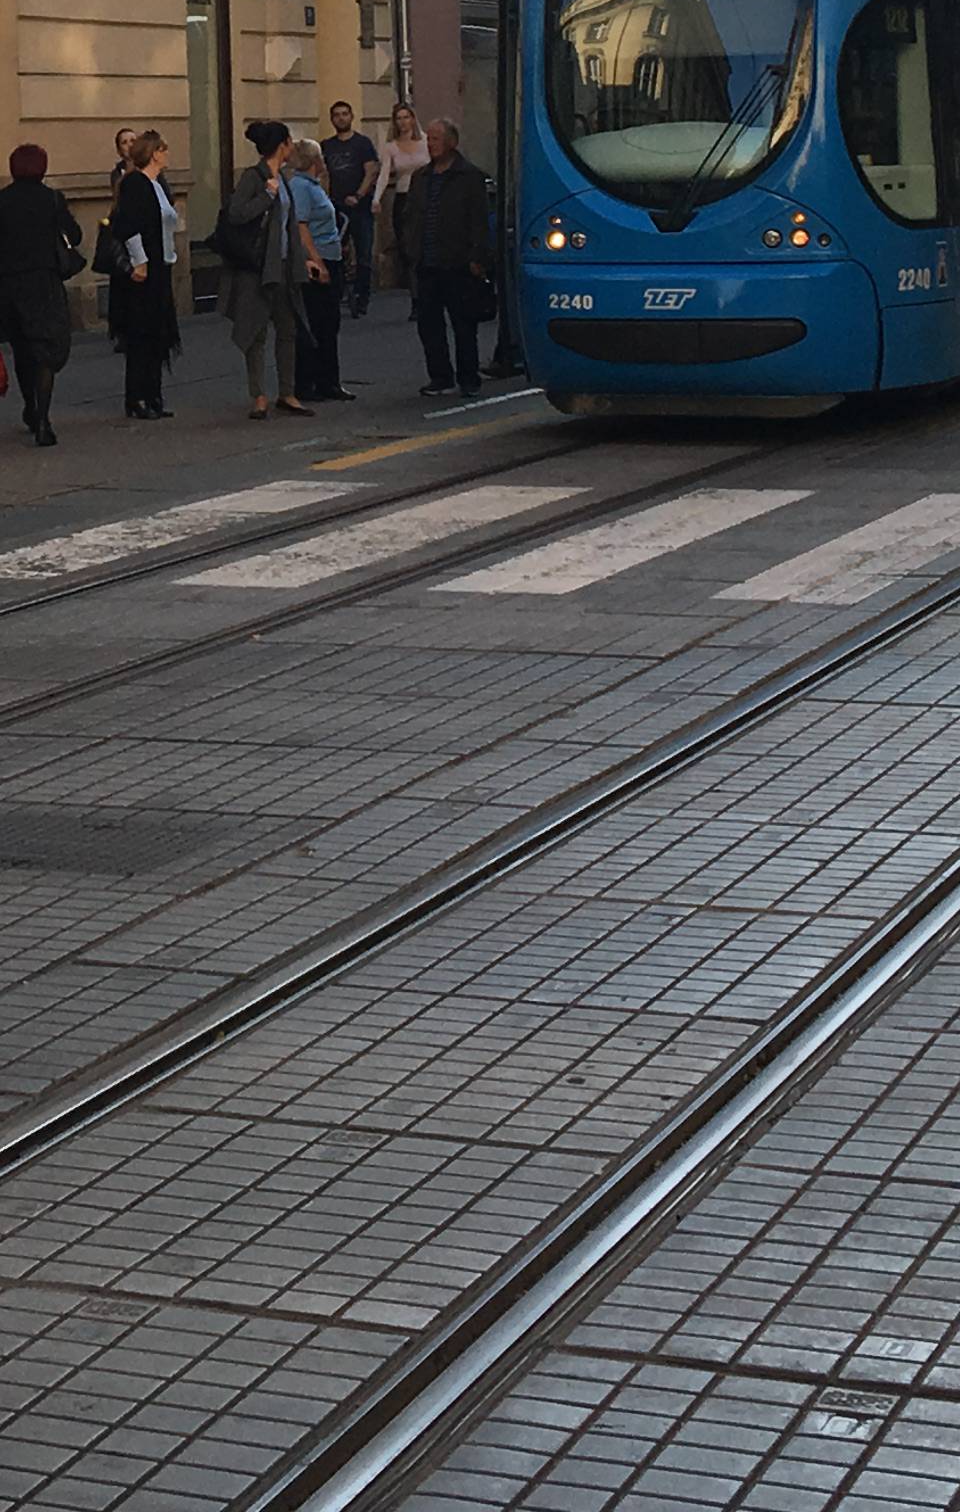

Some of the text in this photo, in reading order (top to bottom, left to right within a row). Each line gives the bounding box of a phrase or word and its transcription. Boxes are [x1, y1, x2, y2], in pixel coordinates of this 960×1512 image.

[898, 267, 931, 292] 2240
[548, 293, 594, 310] 2240
[643, 287, 697, 310] ZET
